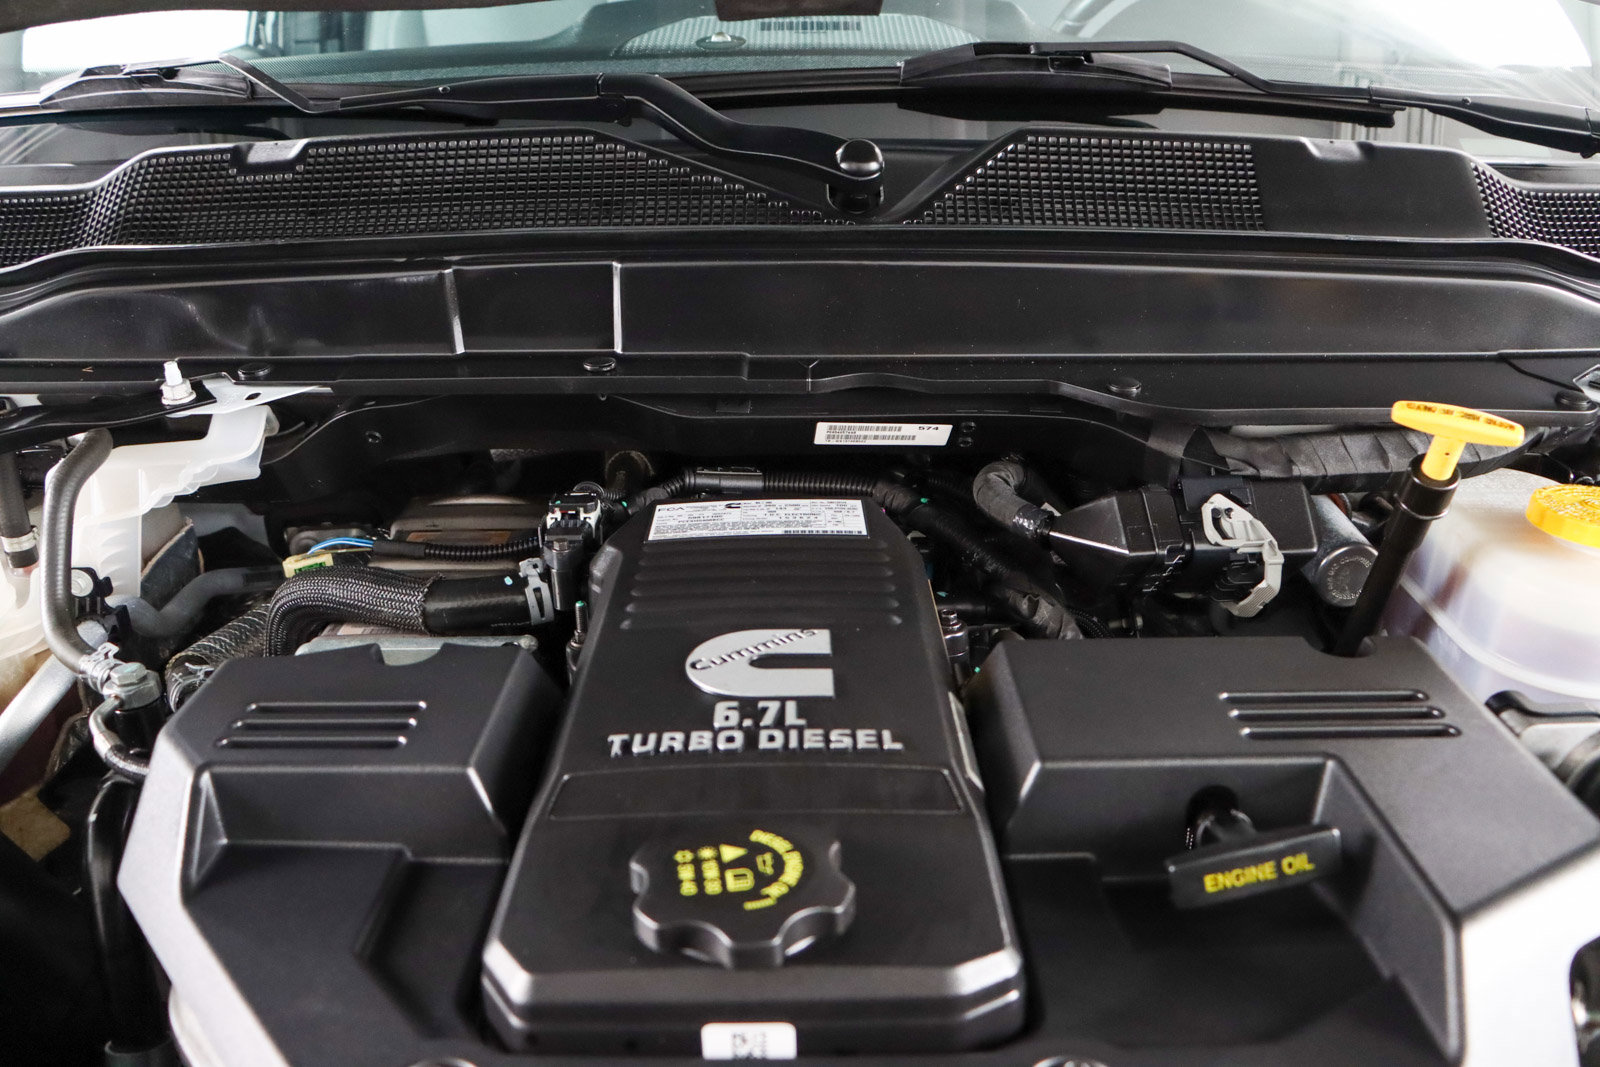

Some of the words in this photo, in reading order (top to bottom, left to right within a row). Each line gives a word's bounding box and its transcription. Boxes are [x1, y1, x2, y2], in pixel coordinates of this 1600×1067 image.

[690, 628, 817, 671] Cummins
[713, 700, 808, 729] 6.7L
[607, 729, 746, 758] TURBO
[757, 728, 905, 752] DIESEL
[1203, 860, 1279, 893] ENGINE
[1281, 853, 1316, 875] OIL
